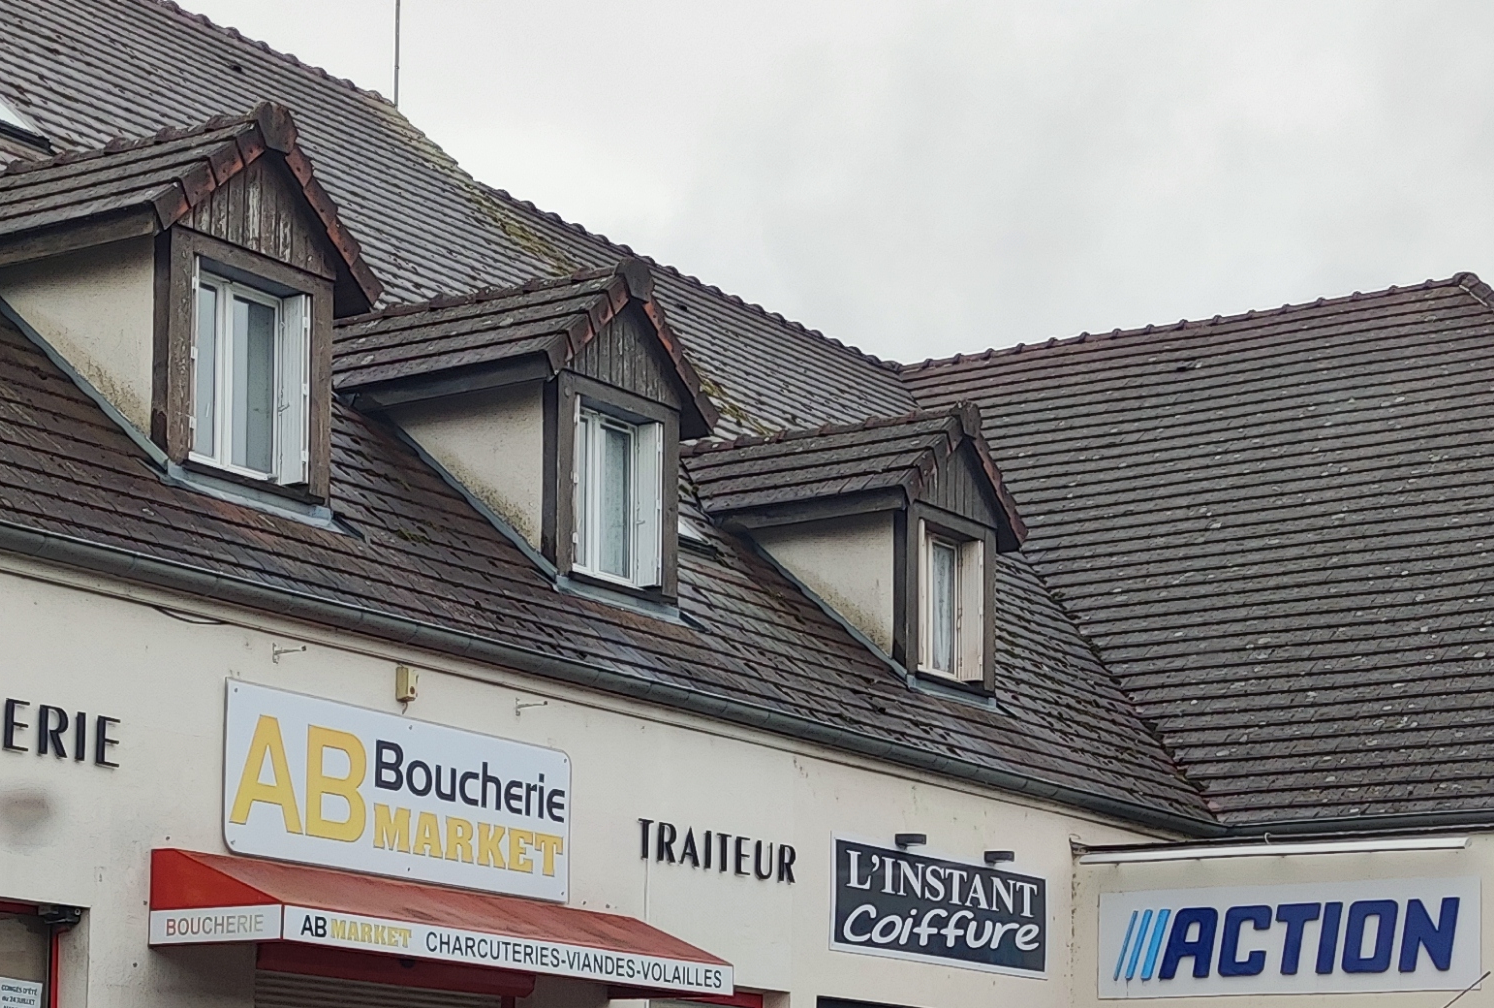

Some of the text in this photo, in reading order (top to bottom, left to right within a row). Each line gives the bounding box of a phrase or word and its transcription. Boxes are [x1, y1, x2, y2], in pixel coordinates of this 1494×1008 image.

[229, 713, 368, 844] AB
[374, 738, 566, 824] Boucherie
[373, 802, 565, 877] MARKET
[637, 817, 797, 884] TRAITEUR
[845, 849, 1039, 919] L'INSTANT
[165, 913, 265, 937] BOUCHERIE
[300, 914, 722, 989] AB MARKET CHARCUTERIES-VIANDES-VOLAILLES
[842, 903, 1041, 952] Coiffure
[1157, 896, 1461, 981] ACTION
